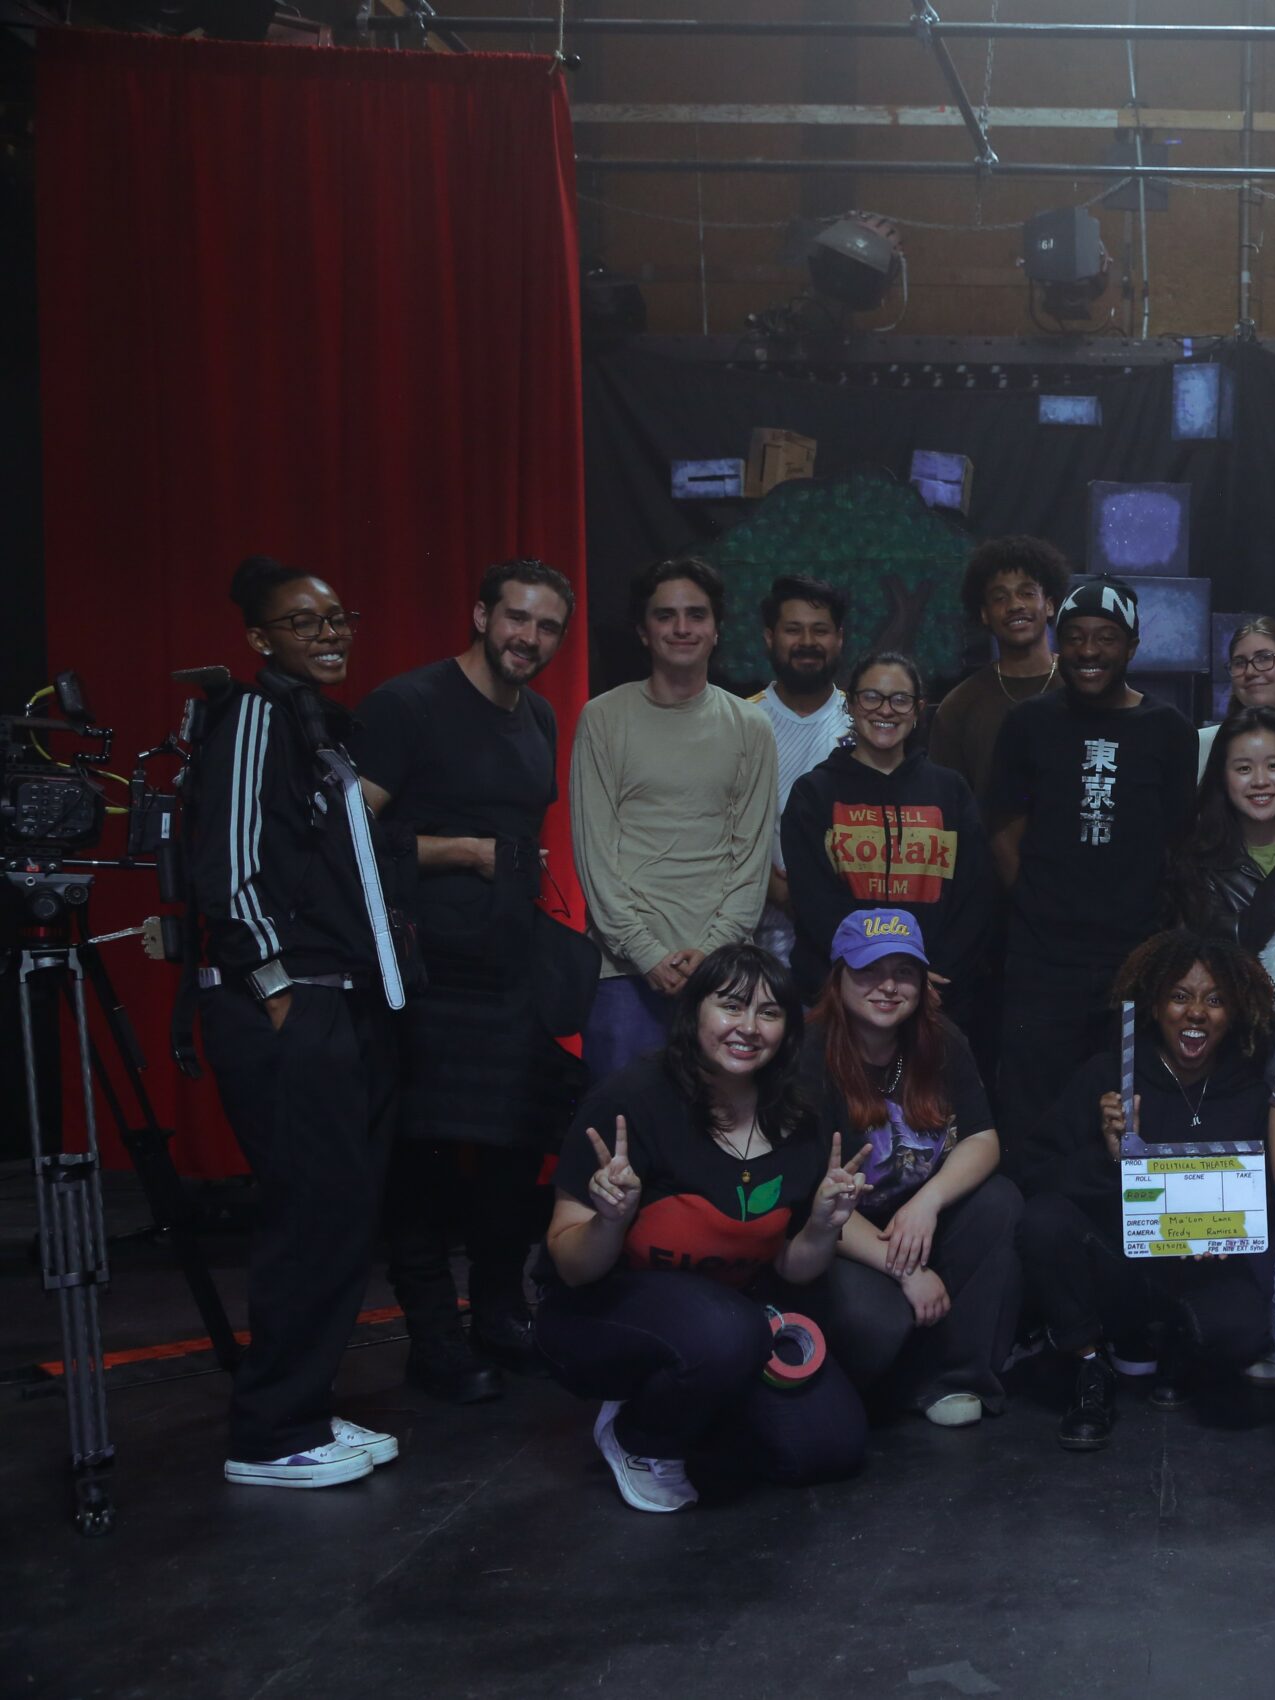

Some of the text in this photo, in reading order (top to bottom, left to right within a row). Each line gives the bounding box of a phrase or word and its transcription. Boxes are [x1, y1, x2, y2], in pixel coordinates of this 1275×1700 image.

[849, 809, 928, 823] WE SELL
[830, 832, 950, 868] Kodak
[863, 916, 911, 938] Ucla
[1153, 1160, 1234, 1171] POLITICAL THEATER
